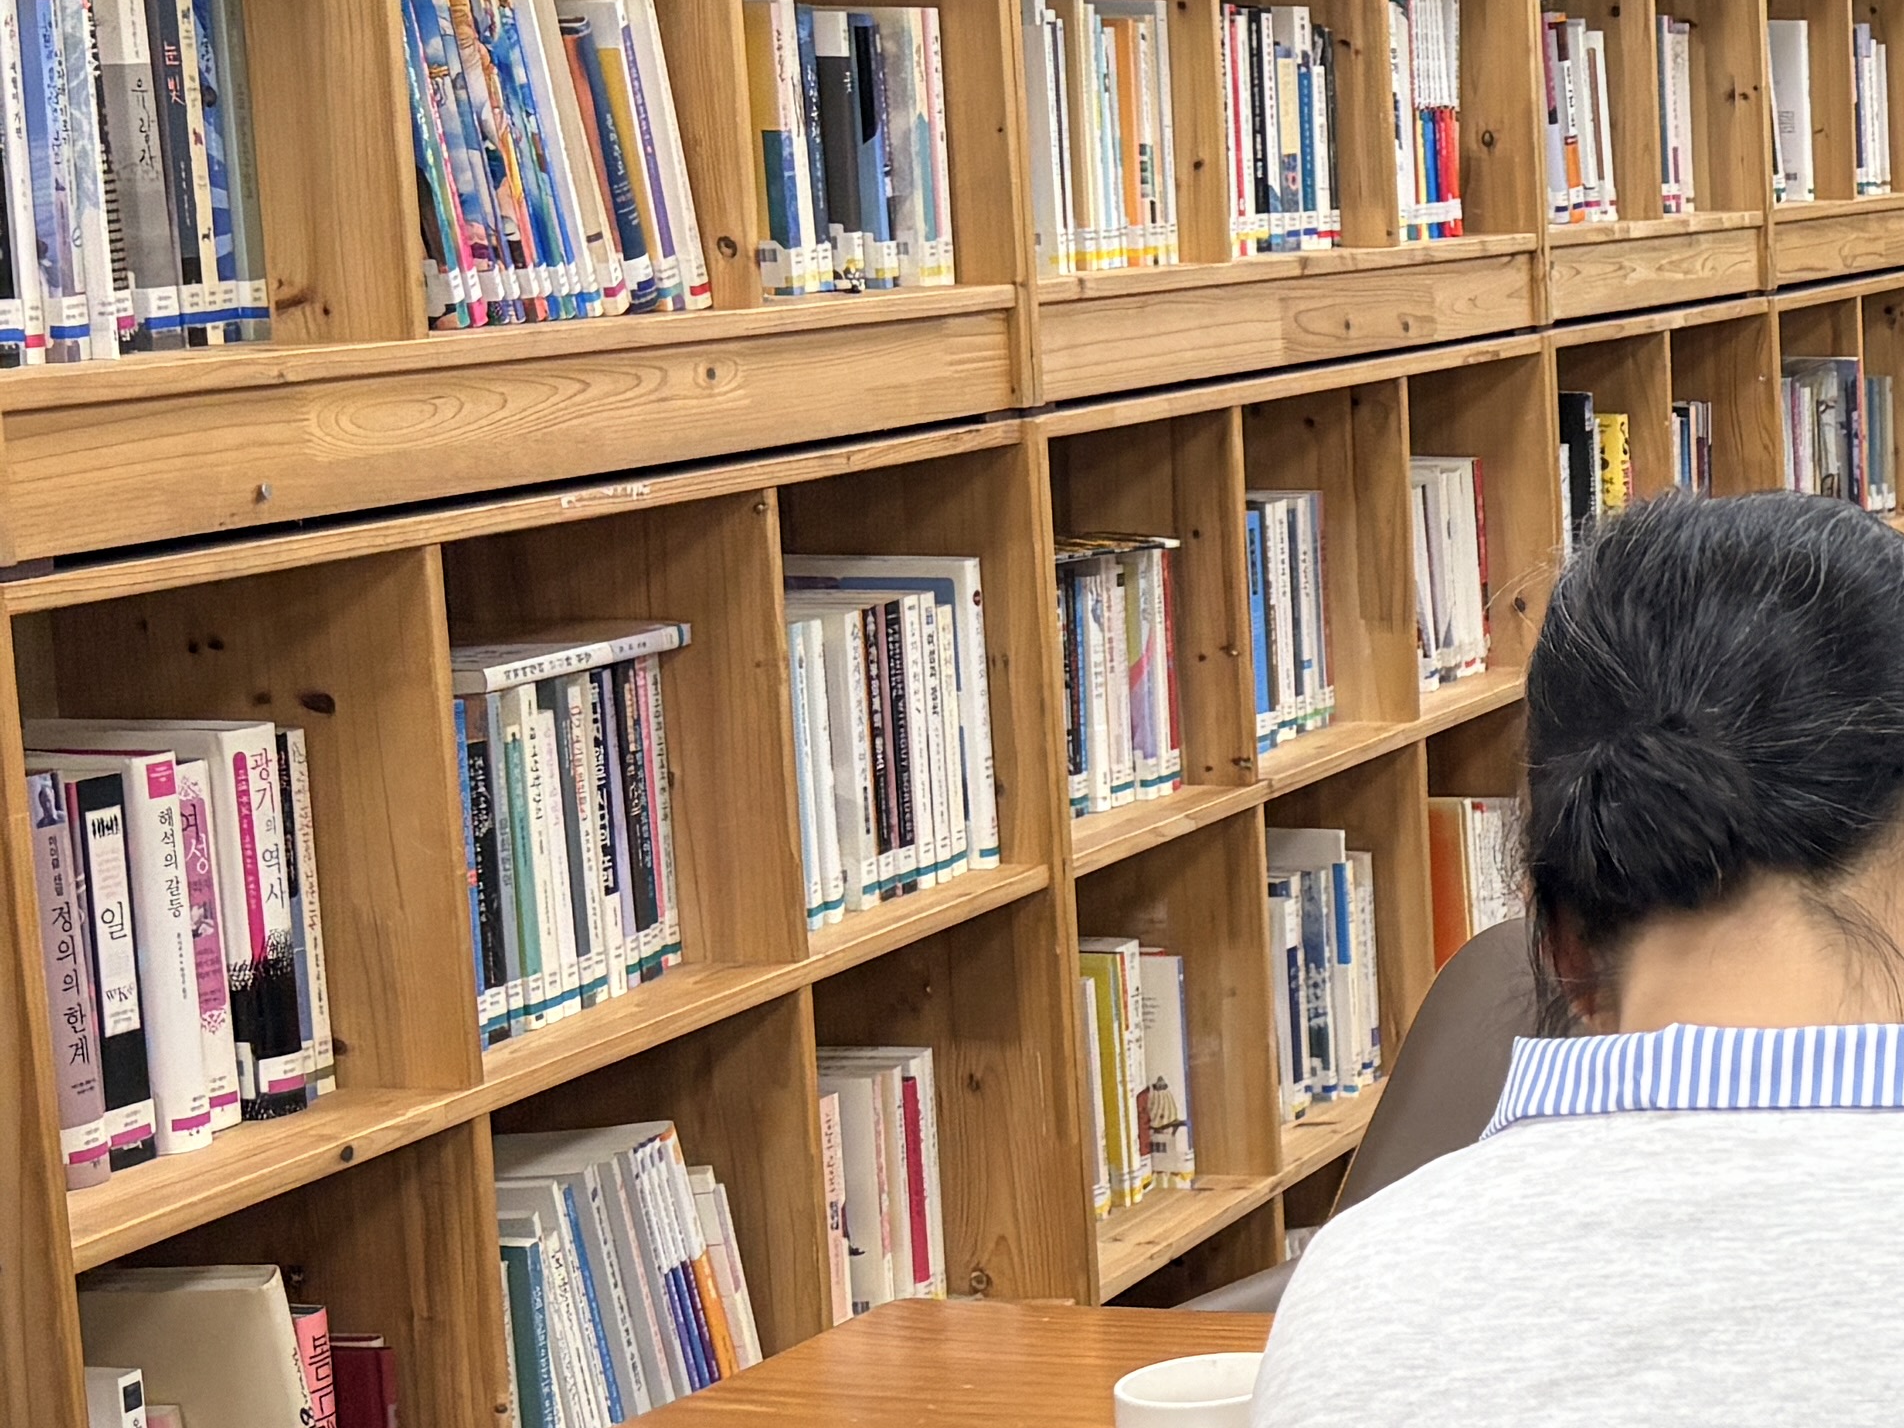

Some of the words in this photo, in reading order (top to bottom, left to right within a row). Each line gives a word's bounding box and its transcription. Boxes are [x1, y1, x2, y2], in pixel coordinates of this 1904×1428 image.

[261, 842, 286, 911] 역사
[100, 902, 128, 941] 일
[63, 1005, 91, 1068] 한계
